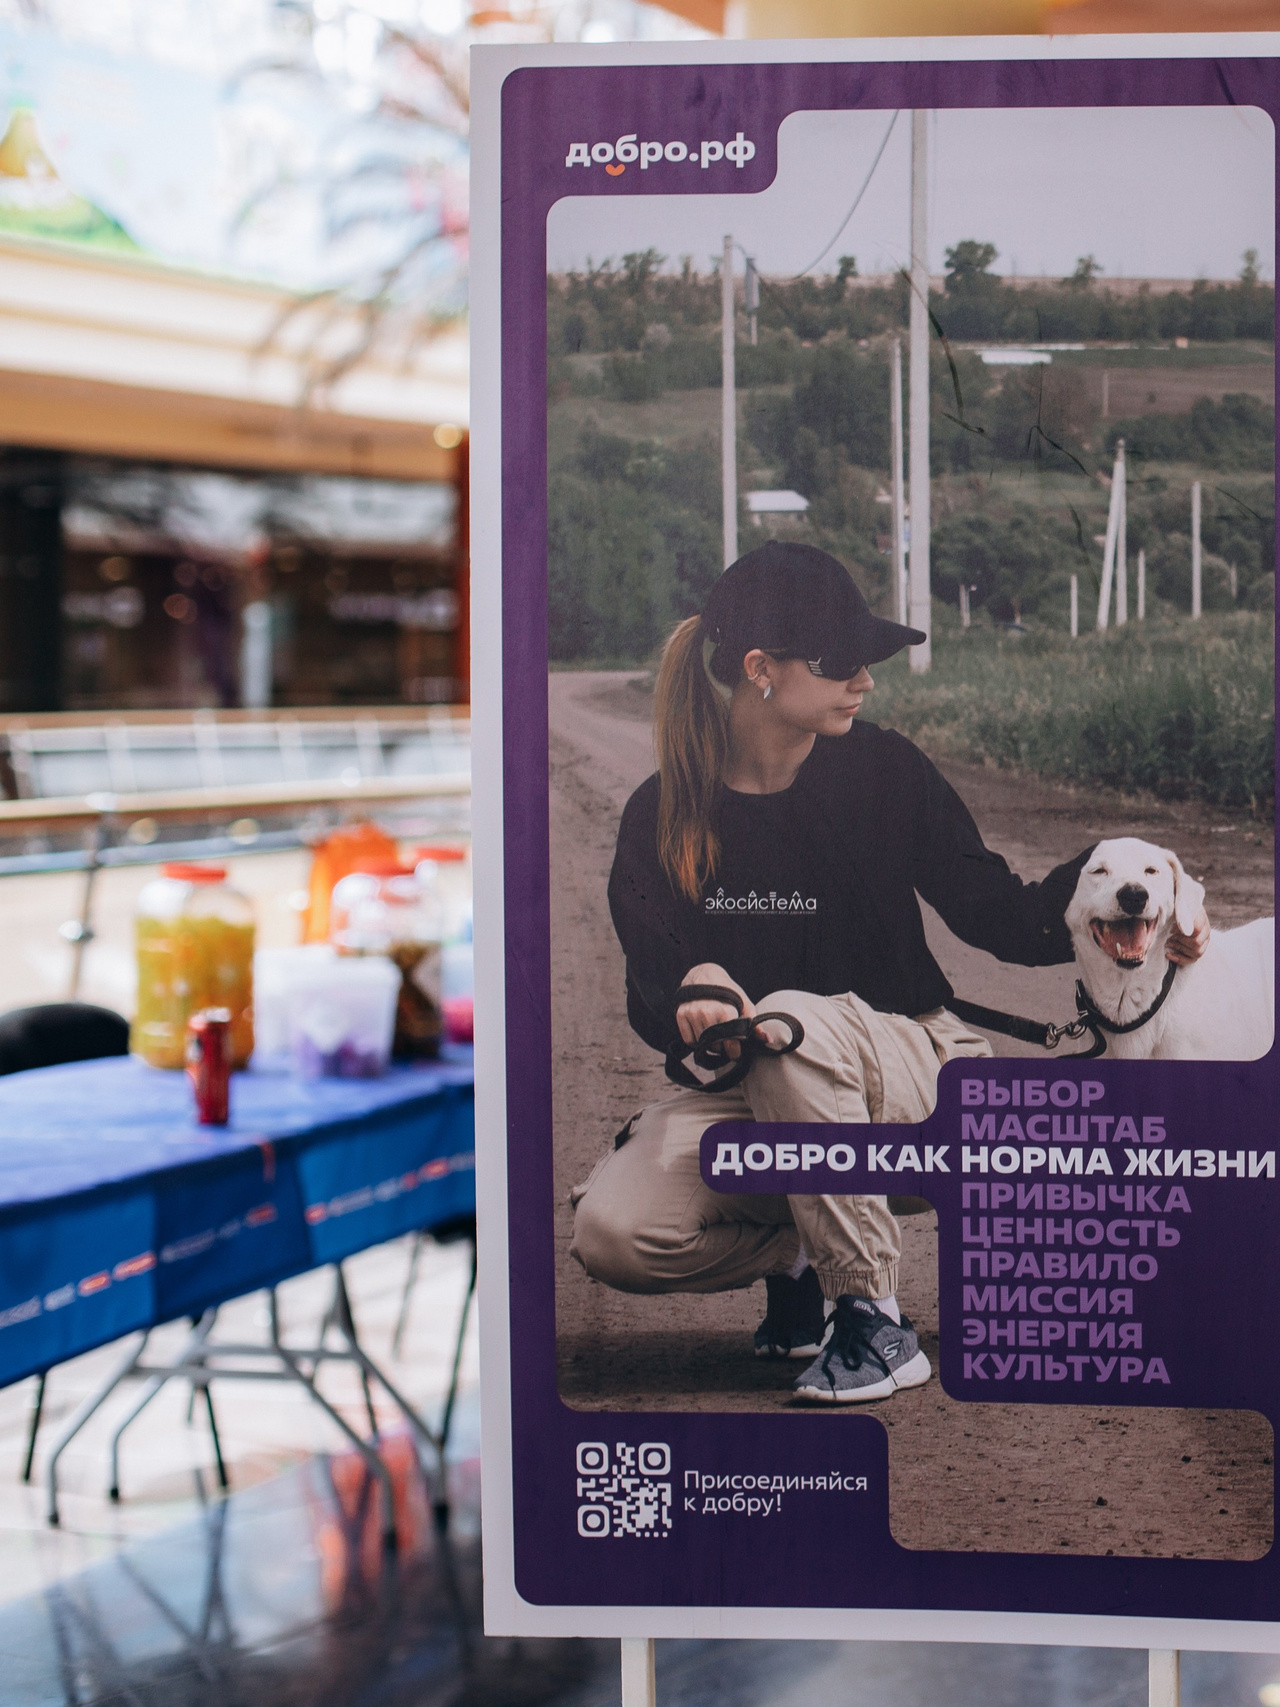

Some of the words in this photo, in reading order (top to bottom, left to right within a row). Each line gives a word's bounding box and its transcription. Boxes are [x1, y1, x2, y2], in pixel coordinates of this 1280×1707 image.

[566, 132, 755, 175] добро.рф
[961, 1079, 1105, 1107] ВЫБОР
[961, 1114, 1166, 1143] МАСШТАБ
[712, 1143, 856, 1175] ДОБРО
[867, 1145, 950, 1173] КАК
[961, 1146, 1113, 1175] НОРМА
[1123, 1149, 1276, 1178] ЖИЗНИ
[961, 1182, 1191, 1213] ПРИВЫЧКА
[962, 1217, 1180, 1248] ЦЕННОСТЬ
[962, 1251, 1158, 1281] ПРАВИЛО
[962, 1285, 1133, 1315] МИССИЯ
[962, 1319, 1142, 1349] ЭНЕРГИЯ
[963, 1353, 1171, 1384] КУЛЬТУРА
[684, 1470, 868, 1493] Присоединяйся
[684, 1497, 696, 1511] к
[703, 1493, 782, 1516] добру!
